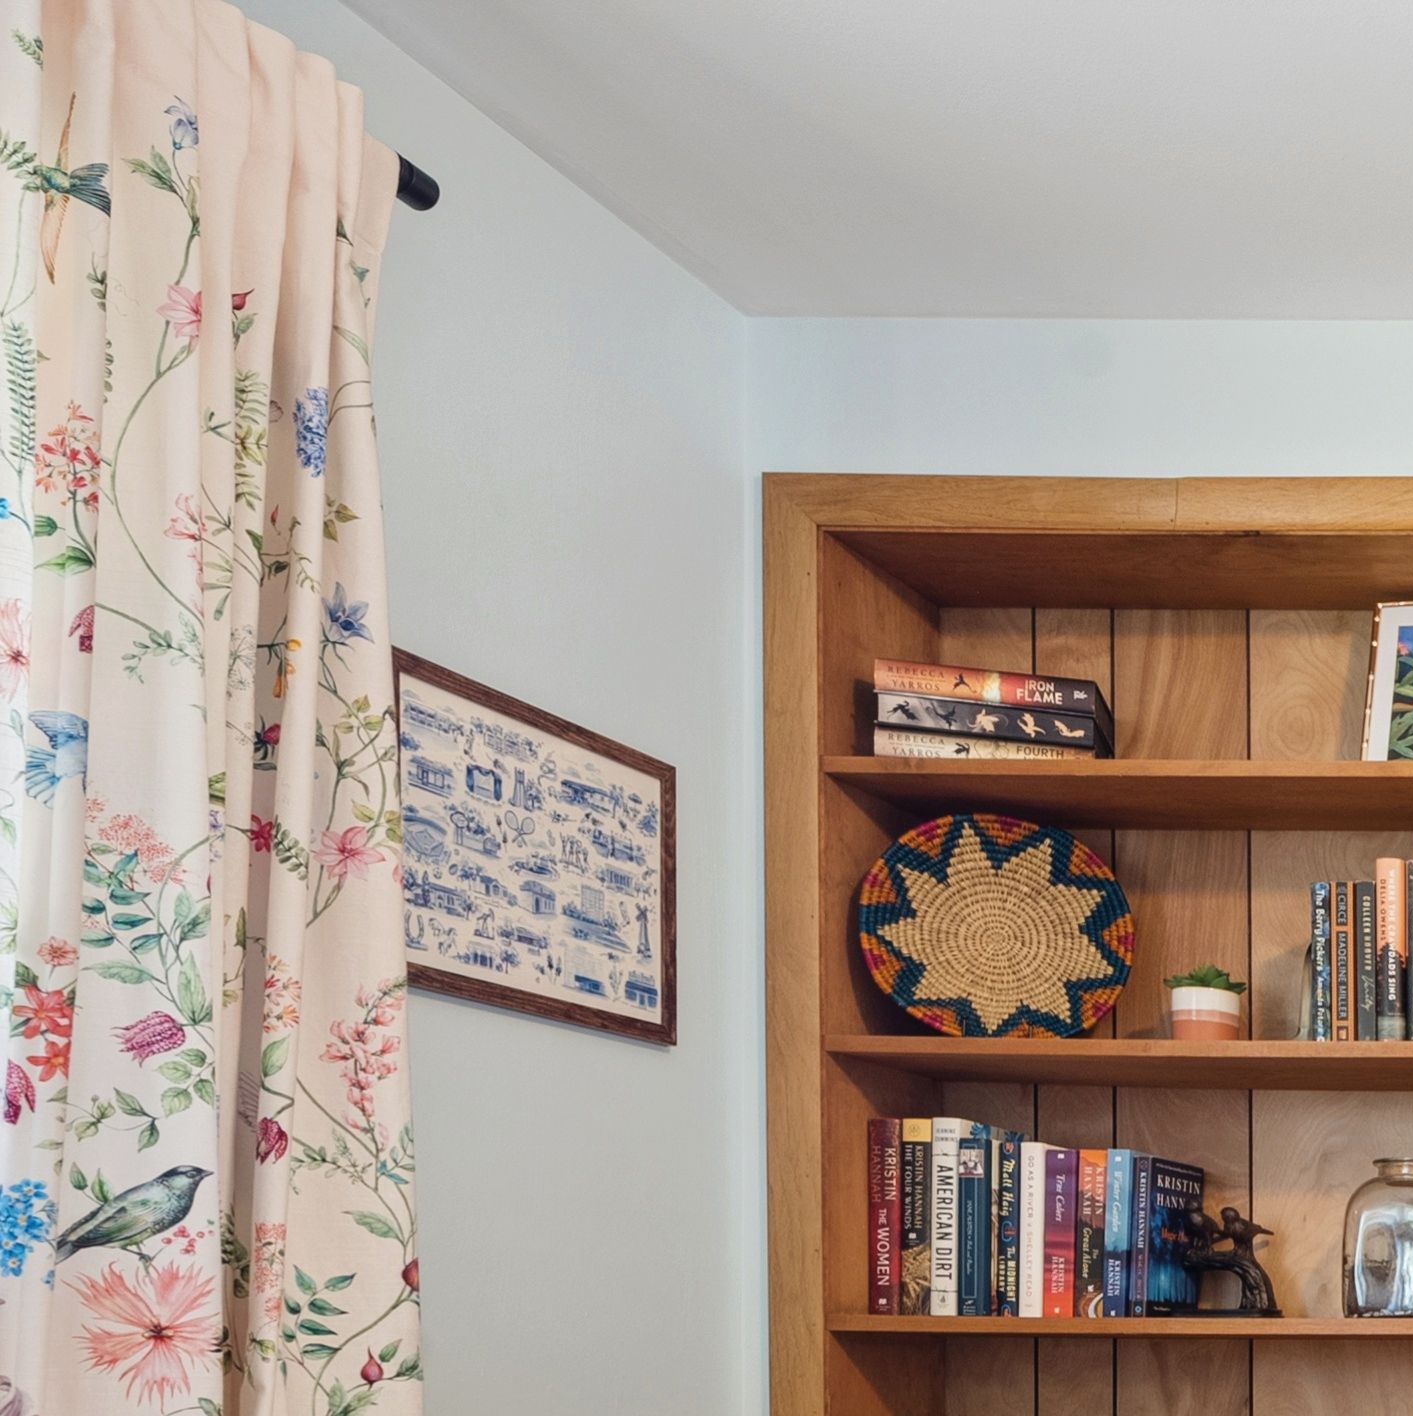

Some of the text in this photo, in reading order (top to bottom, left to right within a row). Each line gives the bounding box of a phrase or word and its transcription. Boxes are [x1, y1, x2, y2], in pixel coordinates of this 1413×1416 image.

[888, 666, 944, 679] REBECCA
[892, 679, 940, 692] YARROS
[1024, 680, 1054, 692] IRON
[1016, 689, 1063, 706] FLAME
[888, 733, 944, 746] REBECCA
[1016, 745, 1065, 760] FOURTH
[1314, 909, 1325, 934] Berry
[1337, 894, 1346, 924] CIRCE
[1379, 879, 1387, 941] DELIA OWENS
[1362, 896, 1371, 971] COLLEEN HOOVER
[1314, 938, 1325, 971] Pickers
[1337, 933, 1346, 1018] MADELINE MILLER
[1387, 977, 1396, 1001] SING
[870, 1146, 882, 1203] HANNAH
[883, 1148, 896, 1201] KRISTIN
[1026, 1155, 1034, 1167] GO
[1026, 1170, 1034, 1181] AS
[904, 1144, 913, 1229] THE FOUR WINDS
[914, 1145, 923, 1229] KRISTIN HANNAH
[1001, 1159, 1015, 1217] Matt Haig
[1082, 1166, 1093, 1215] HANNAH
[1094, 1166, 1104, 1215] KRISTIN
[1137, 1172, 1147, 1207] KRISTIN
[1157, 1174, 1201, 1195] KRISTIN
[935, 1164, 954, 1240] AMERICAN
[1026, 1192, 1034, 1218] RIVER
[1082, 1227, 1092, 1250] Great
[1137, 1210, 1147, 1248] HANNAH
[876, 1209, 890, 1286] THE WOMEN
[935, 1248, 954, 1280] DIRT
[1007, 1246, 1016, 1302] The MIDNIGHT
[1107, 1258, 1115, 1296] HANNAH
